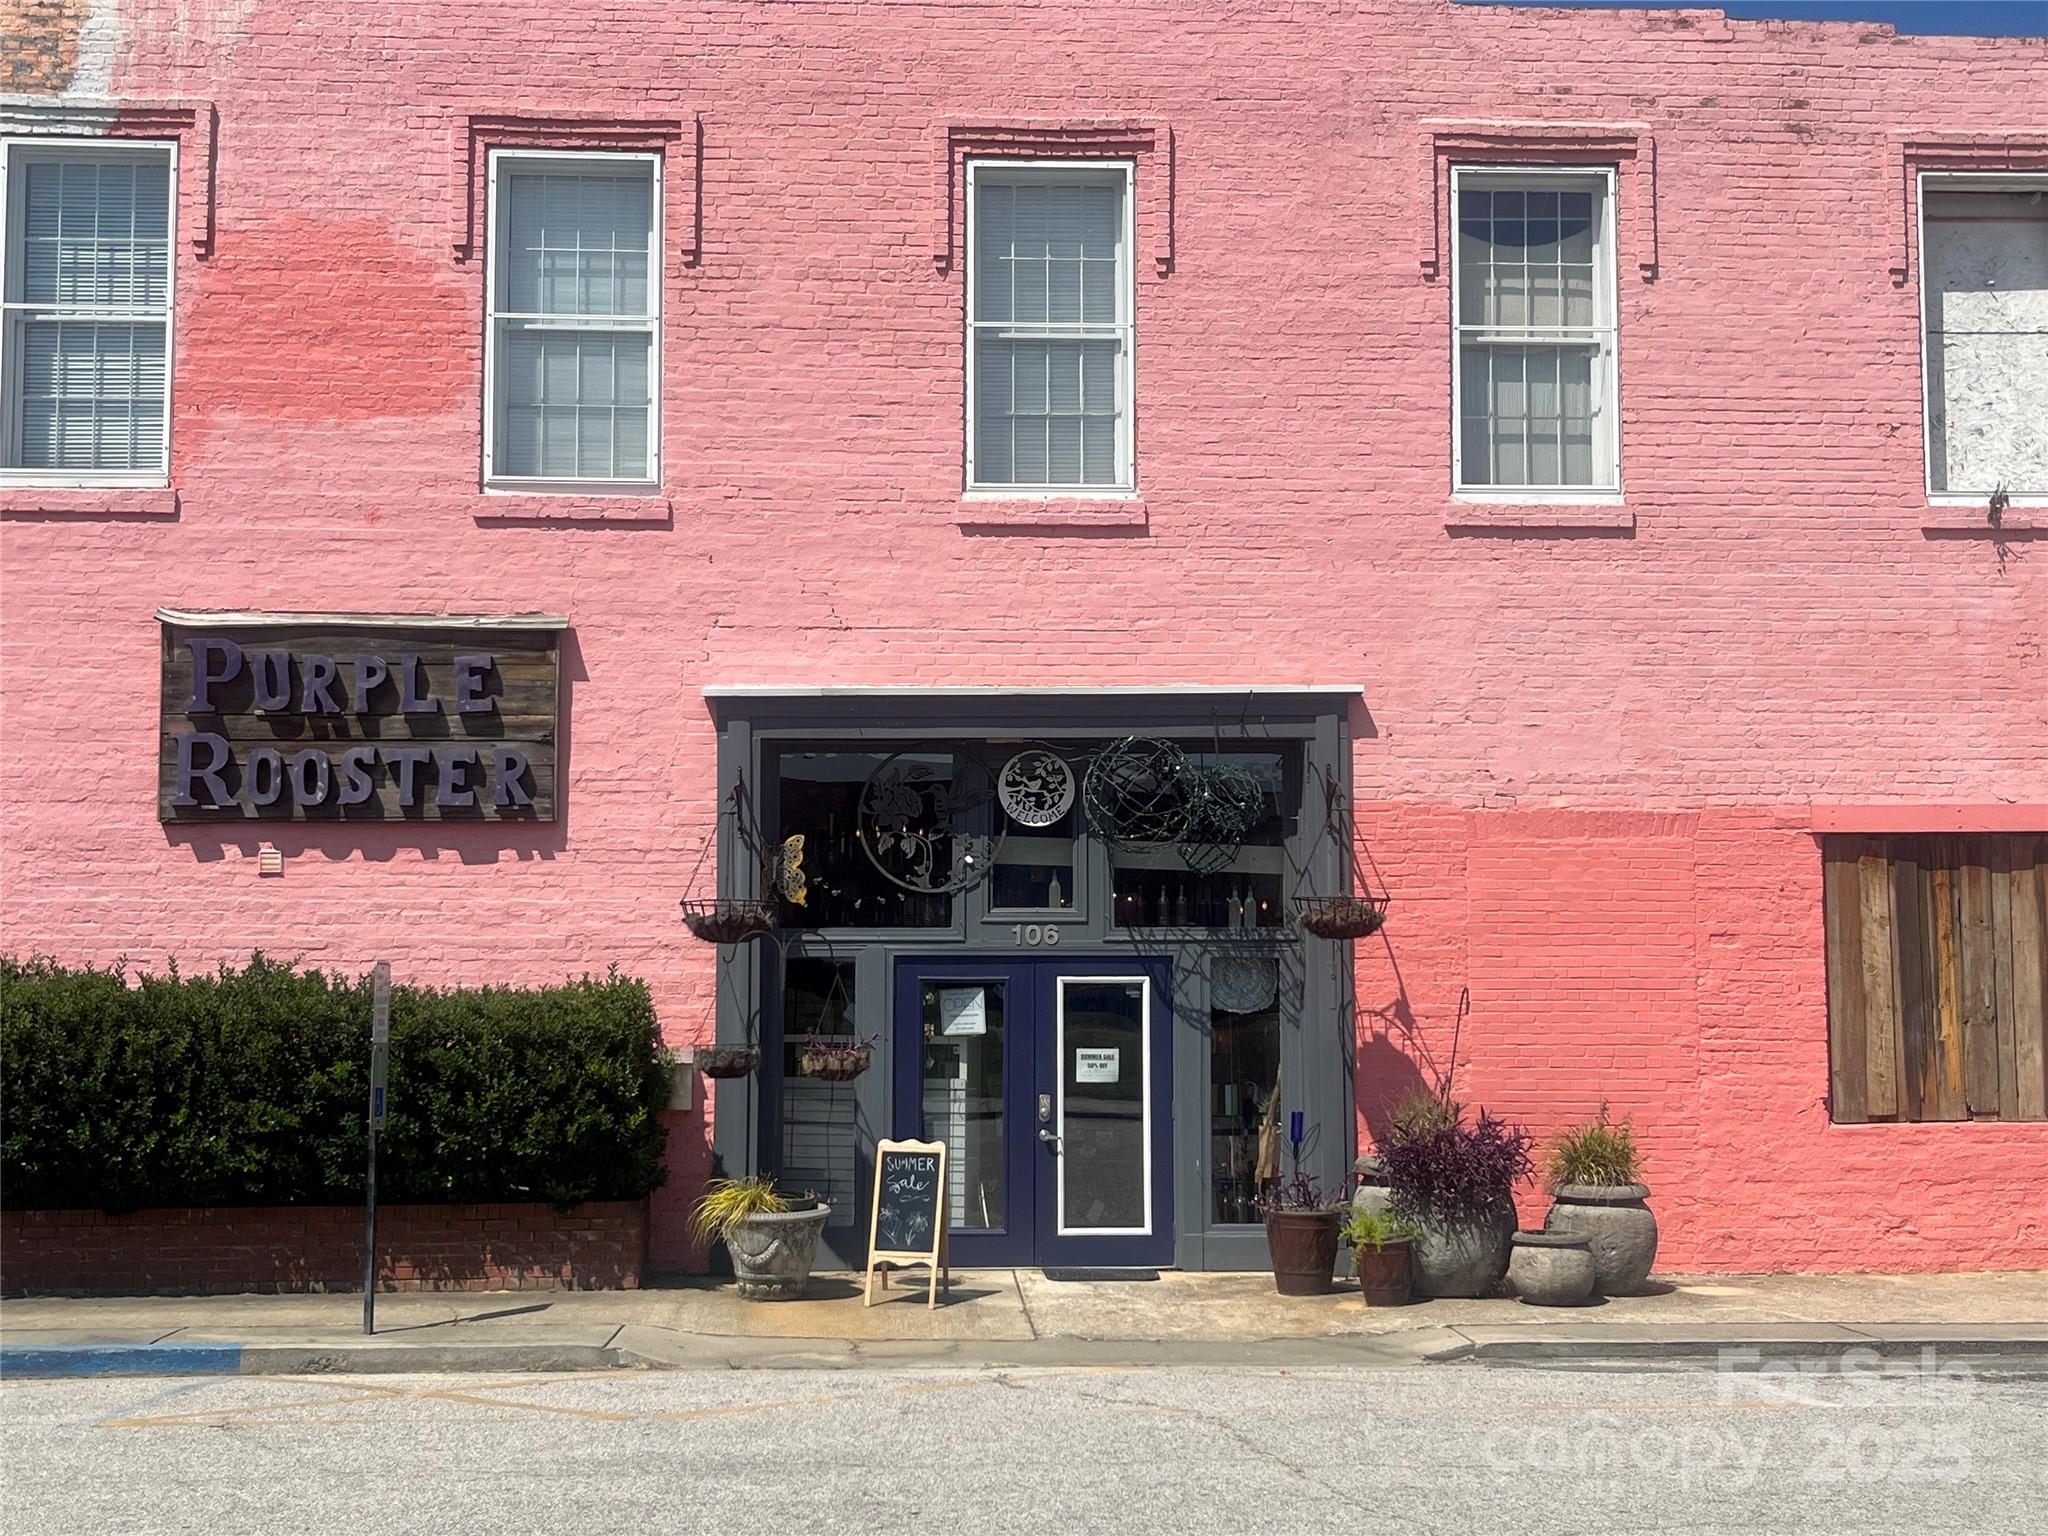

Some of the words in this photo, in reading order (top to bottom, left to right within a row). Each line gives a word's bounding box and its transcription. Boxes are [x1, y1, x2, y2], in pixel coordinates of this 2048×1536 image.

[184, 638, 494, 714] PURPLE
[170, 733, 534, 807] ROOSTER
[1006, 802, 1065, 825] WELCOME
[1011, 923, 1060, 946] 106
[943, 997, 984, 1011] OPEN
[886, 1156, 935, 1172] SUMMER
[886, 1174, 930, 1194] Sale
